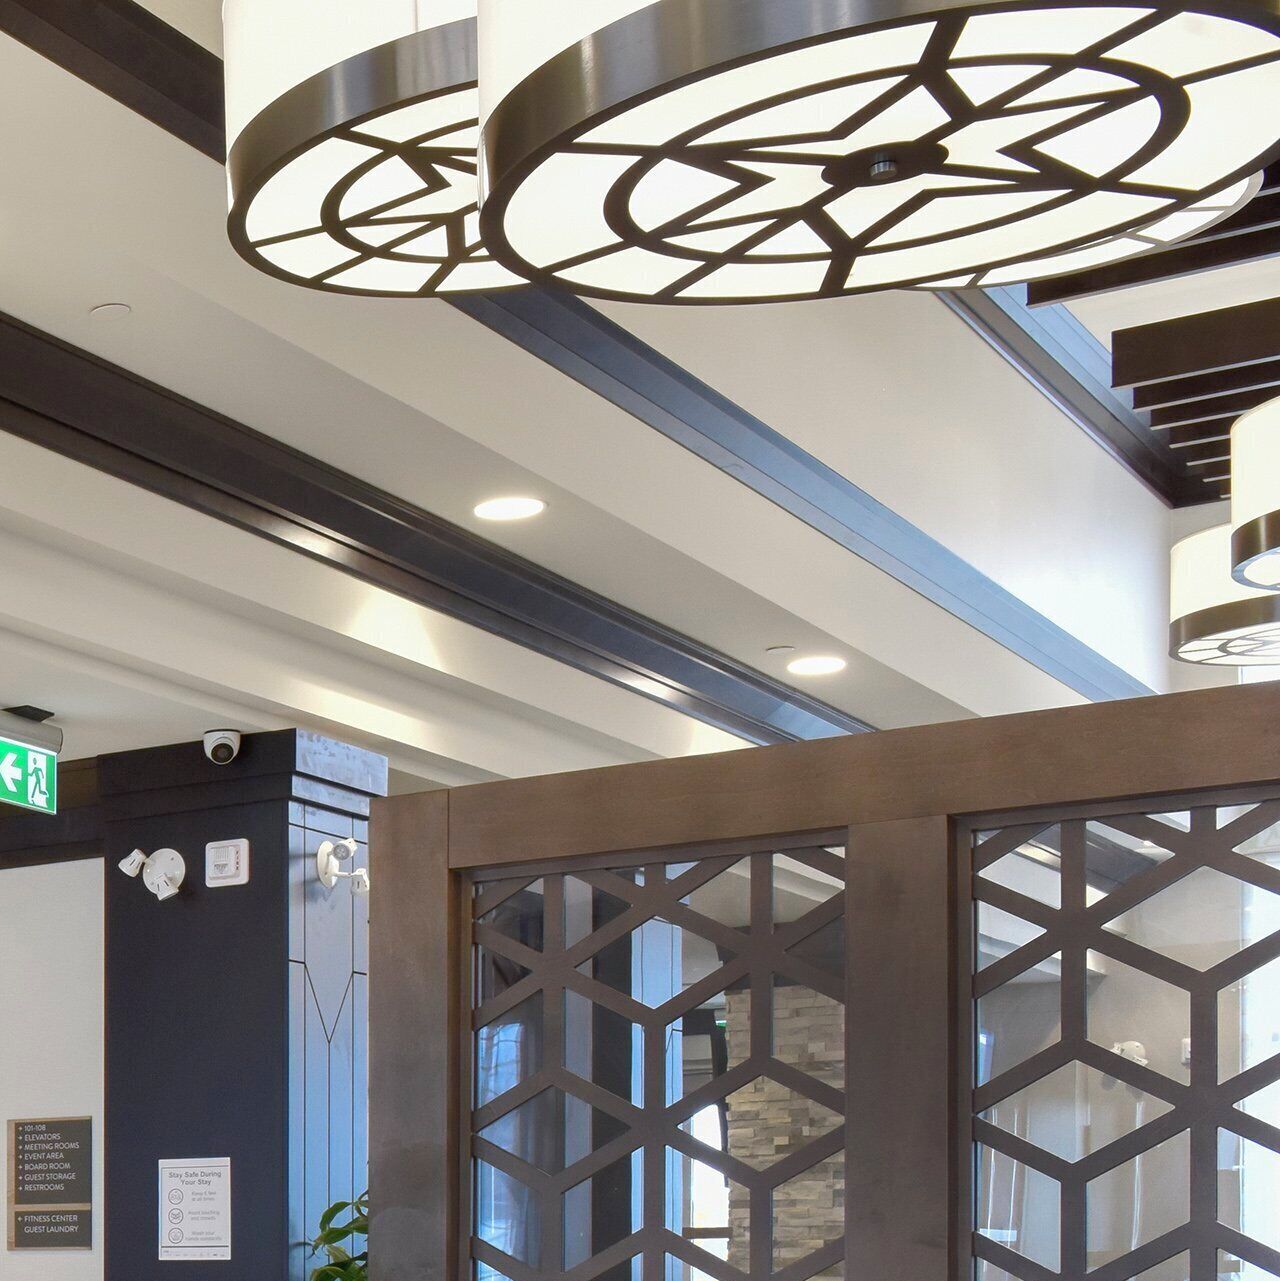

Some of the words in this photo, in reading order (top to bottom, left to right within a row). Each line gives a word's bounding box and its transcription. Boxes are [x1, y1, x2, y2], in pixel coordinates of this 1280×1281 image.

[24, 1133, 60, 1141] ELEVATORS
[24, 1143, 53, 1151] MEETING
[54, 1142, 80, 1150] ROOMS
[46, 1172, 76, 1180] STORAGE
[24, 1215, 50, 1223] FITNESS
[46, 1225, 79, 1233] LAUNDRY
